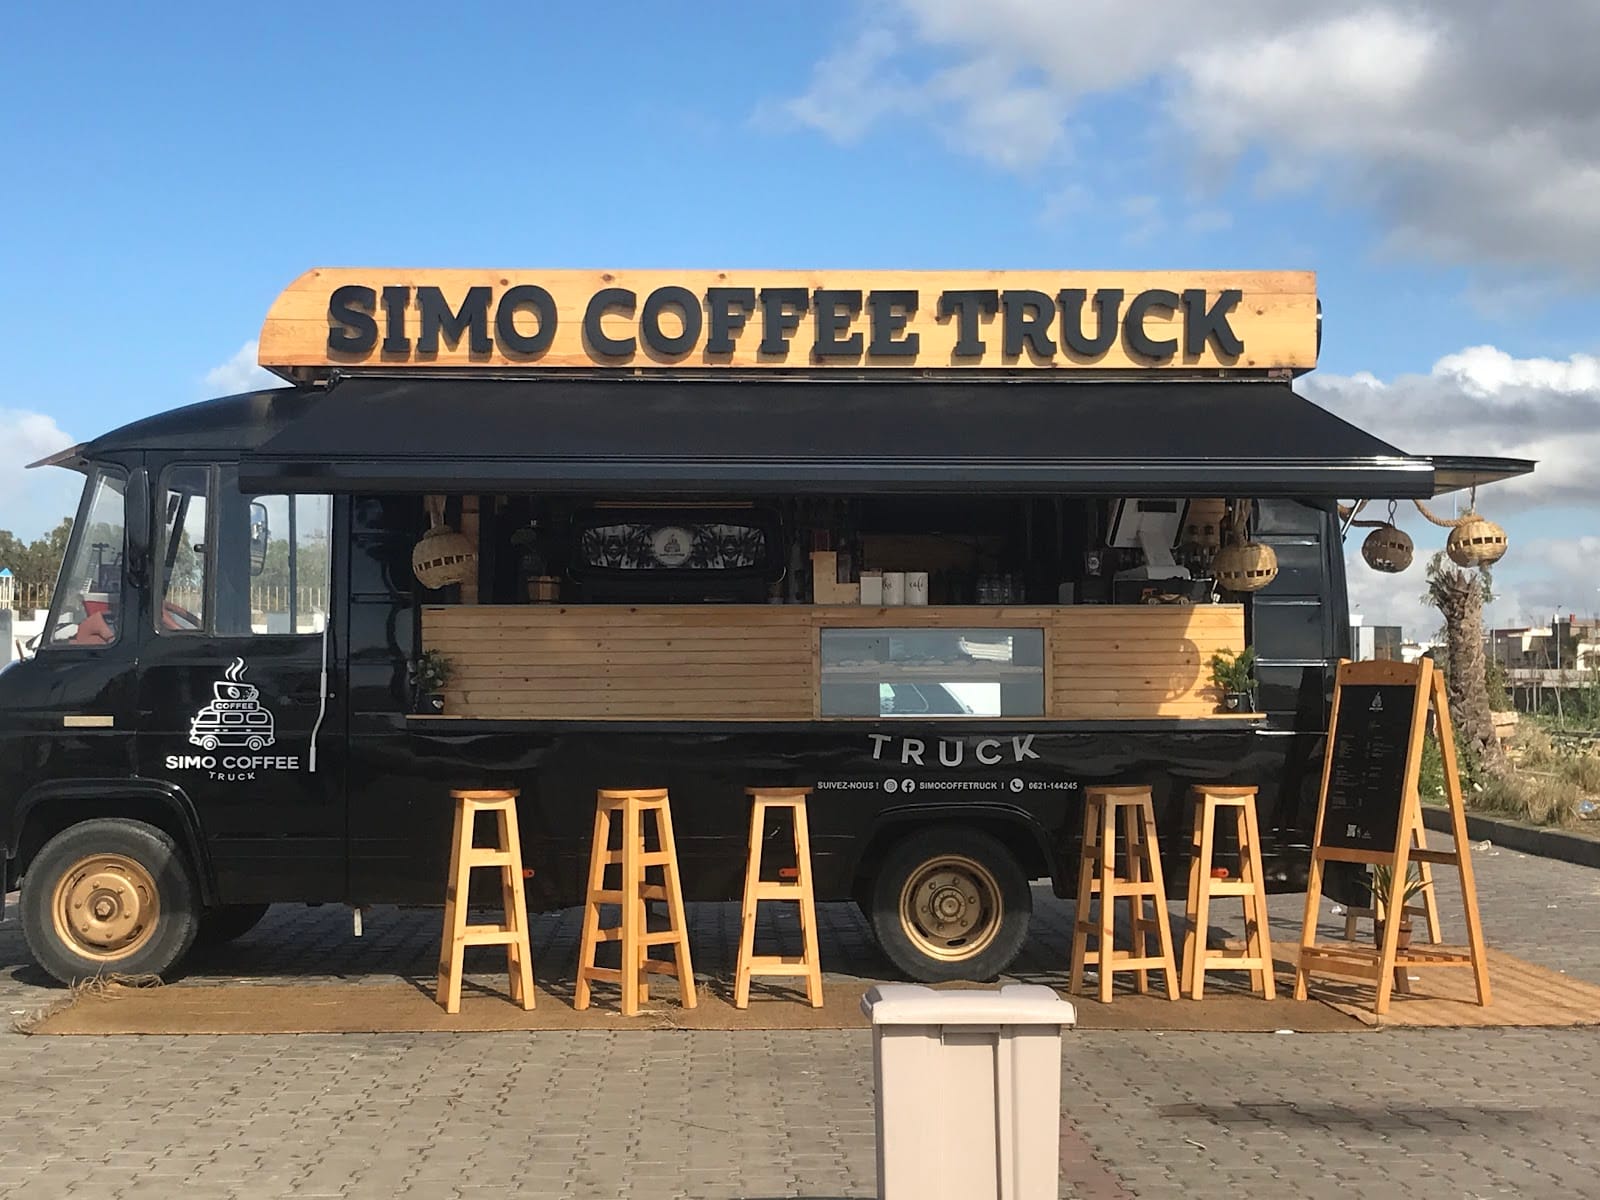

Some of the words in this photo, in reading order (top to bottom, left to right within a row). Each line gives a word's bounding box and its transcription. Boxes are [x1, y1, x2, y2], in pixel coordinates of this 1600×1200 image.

[328, 284, 558, 356] SIMO
[584, 285, 920, 358] COFFEE
[940, 288, 1245, 359] TRUCK
[215, 702, 254, 710] COFFEE
[867, 733, 1041, 767] TRUCK
[165, 755, 217, 770] SIMO
[222, 756, 300, 770] COFFEE
[208, 771, 256, 781] TRUCK
[817, 781, 875, 790] SUIVEZ-NOUS
[919, 781, 998, 790] SIMOCOFFETRUCK
[1028, 781, 1078, 790] 0621-144245
